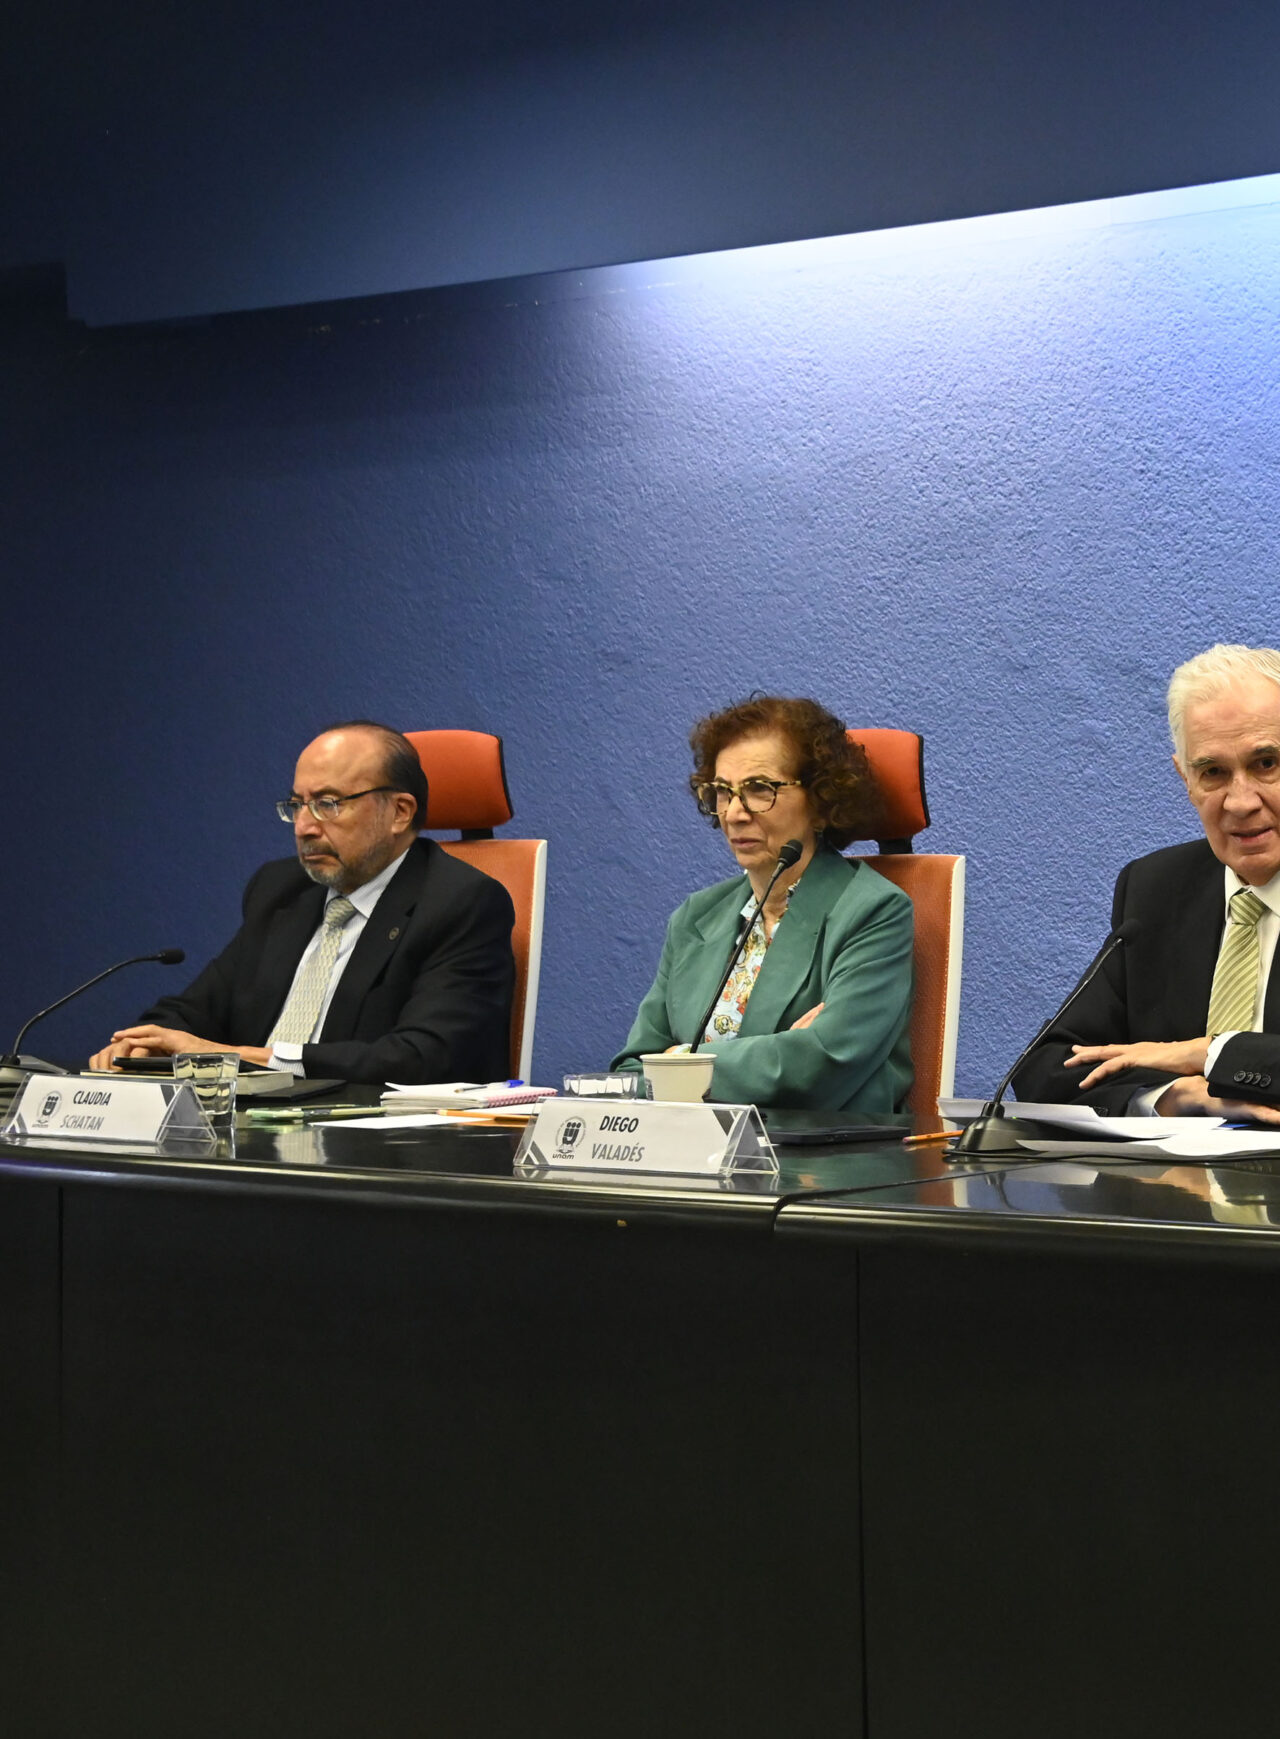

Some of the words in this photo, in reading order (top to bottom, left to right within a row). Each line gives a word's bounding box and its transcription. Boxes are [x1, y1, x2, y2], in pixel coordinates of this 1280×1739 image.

[73, 1090, 112, 1106] CLAUDIA
[60, 1114, 104, 1131] SCHATAN
[599, 1115, 639, 1133] DIEGO
[591, 1142, 645, 1162] VALADÉS
